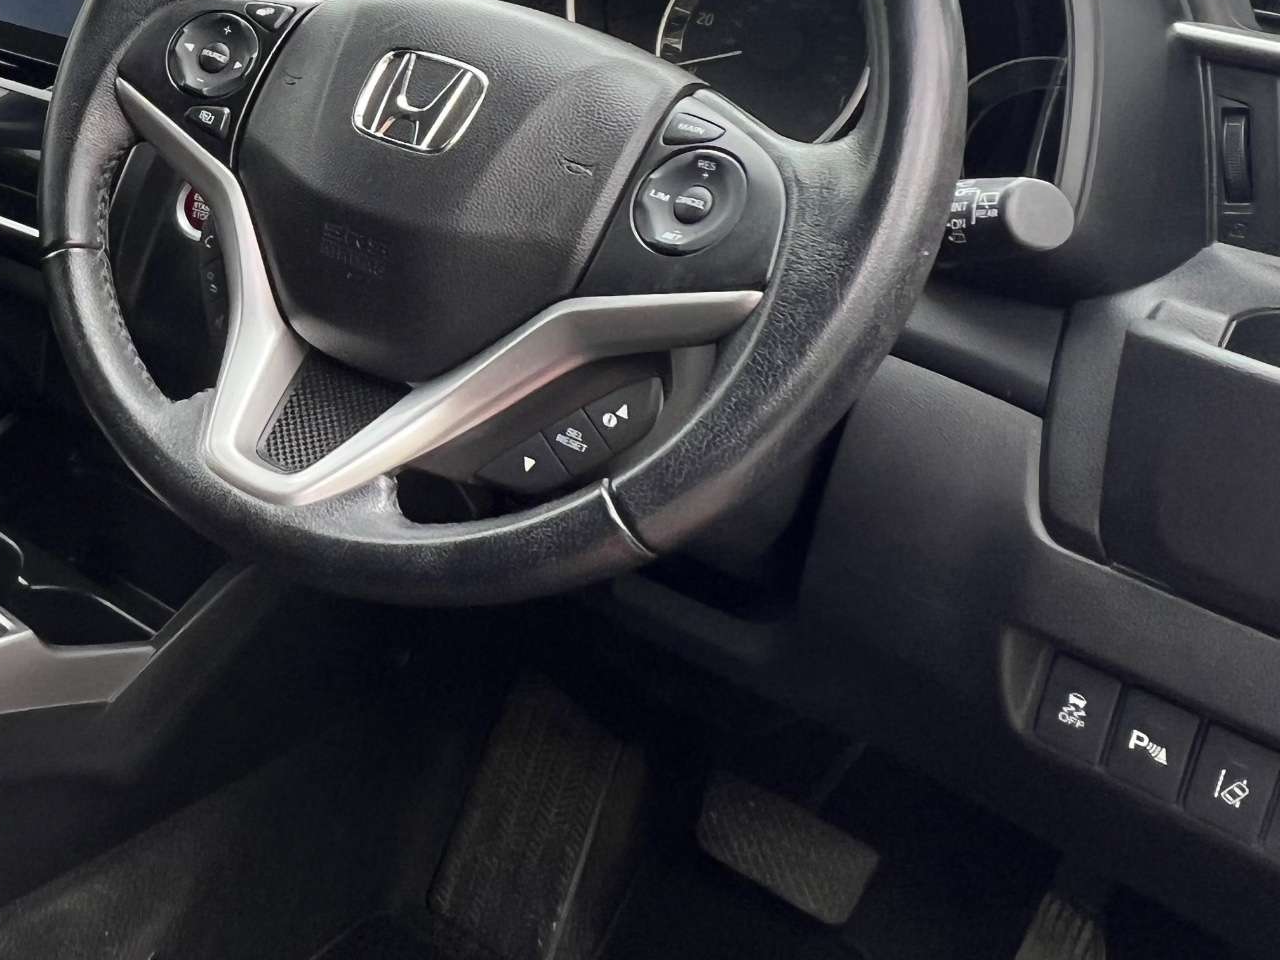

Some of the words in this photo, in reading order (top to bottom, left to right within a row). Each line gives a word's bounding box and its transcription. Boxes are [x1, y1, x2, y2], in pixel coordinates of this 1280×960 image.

[696, 12, 715, 27] 20
[678, 122, 705, 136] MAIN
[697, 159, 717, 171] RES
[1057, 710, 1086, 729] OFF
